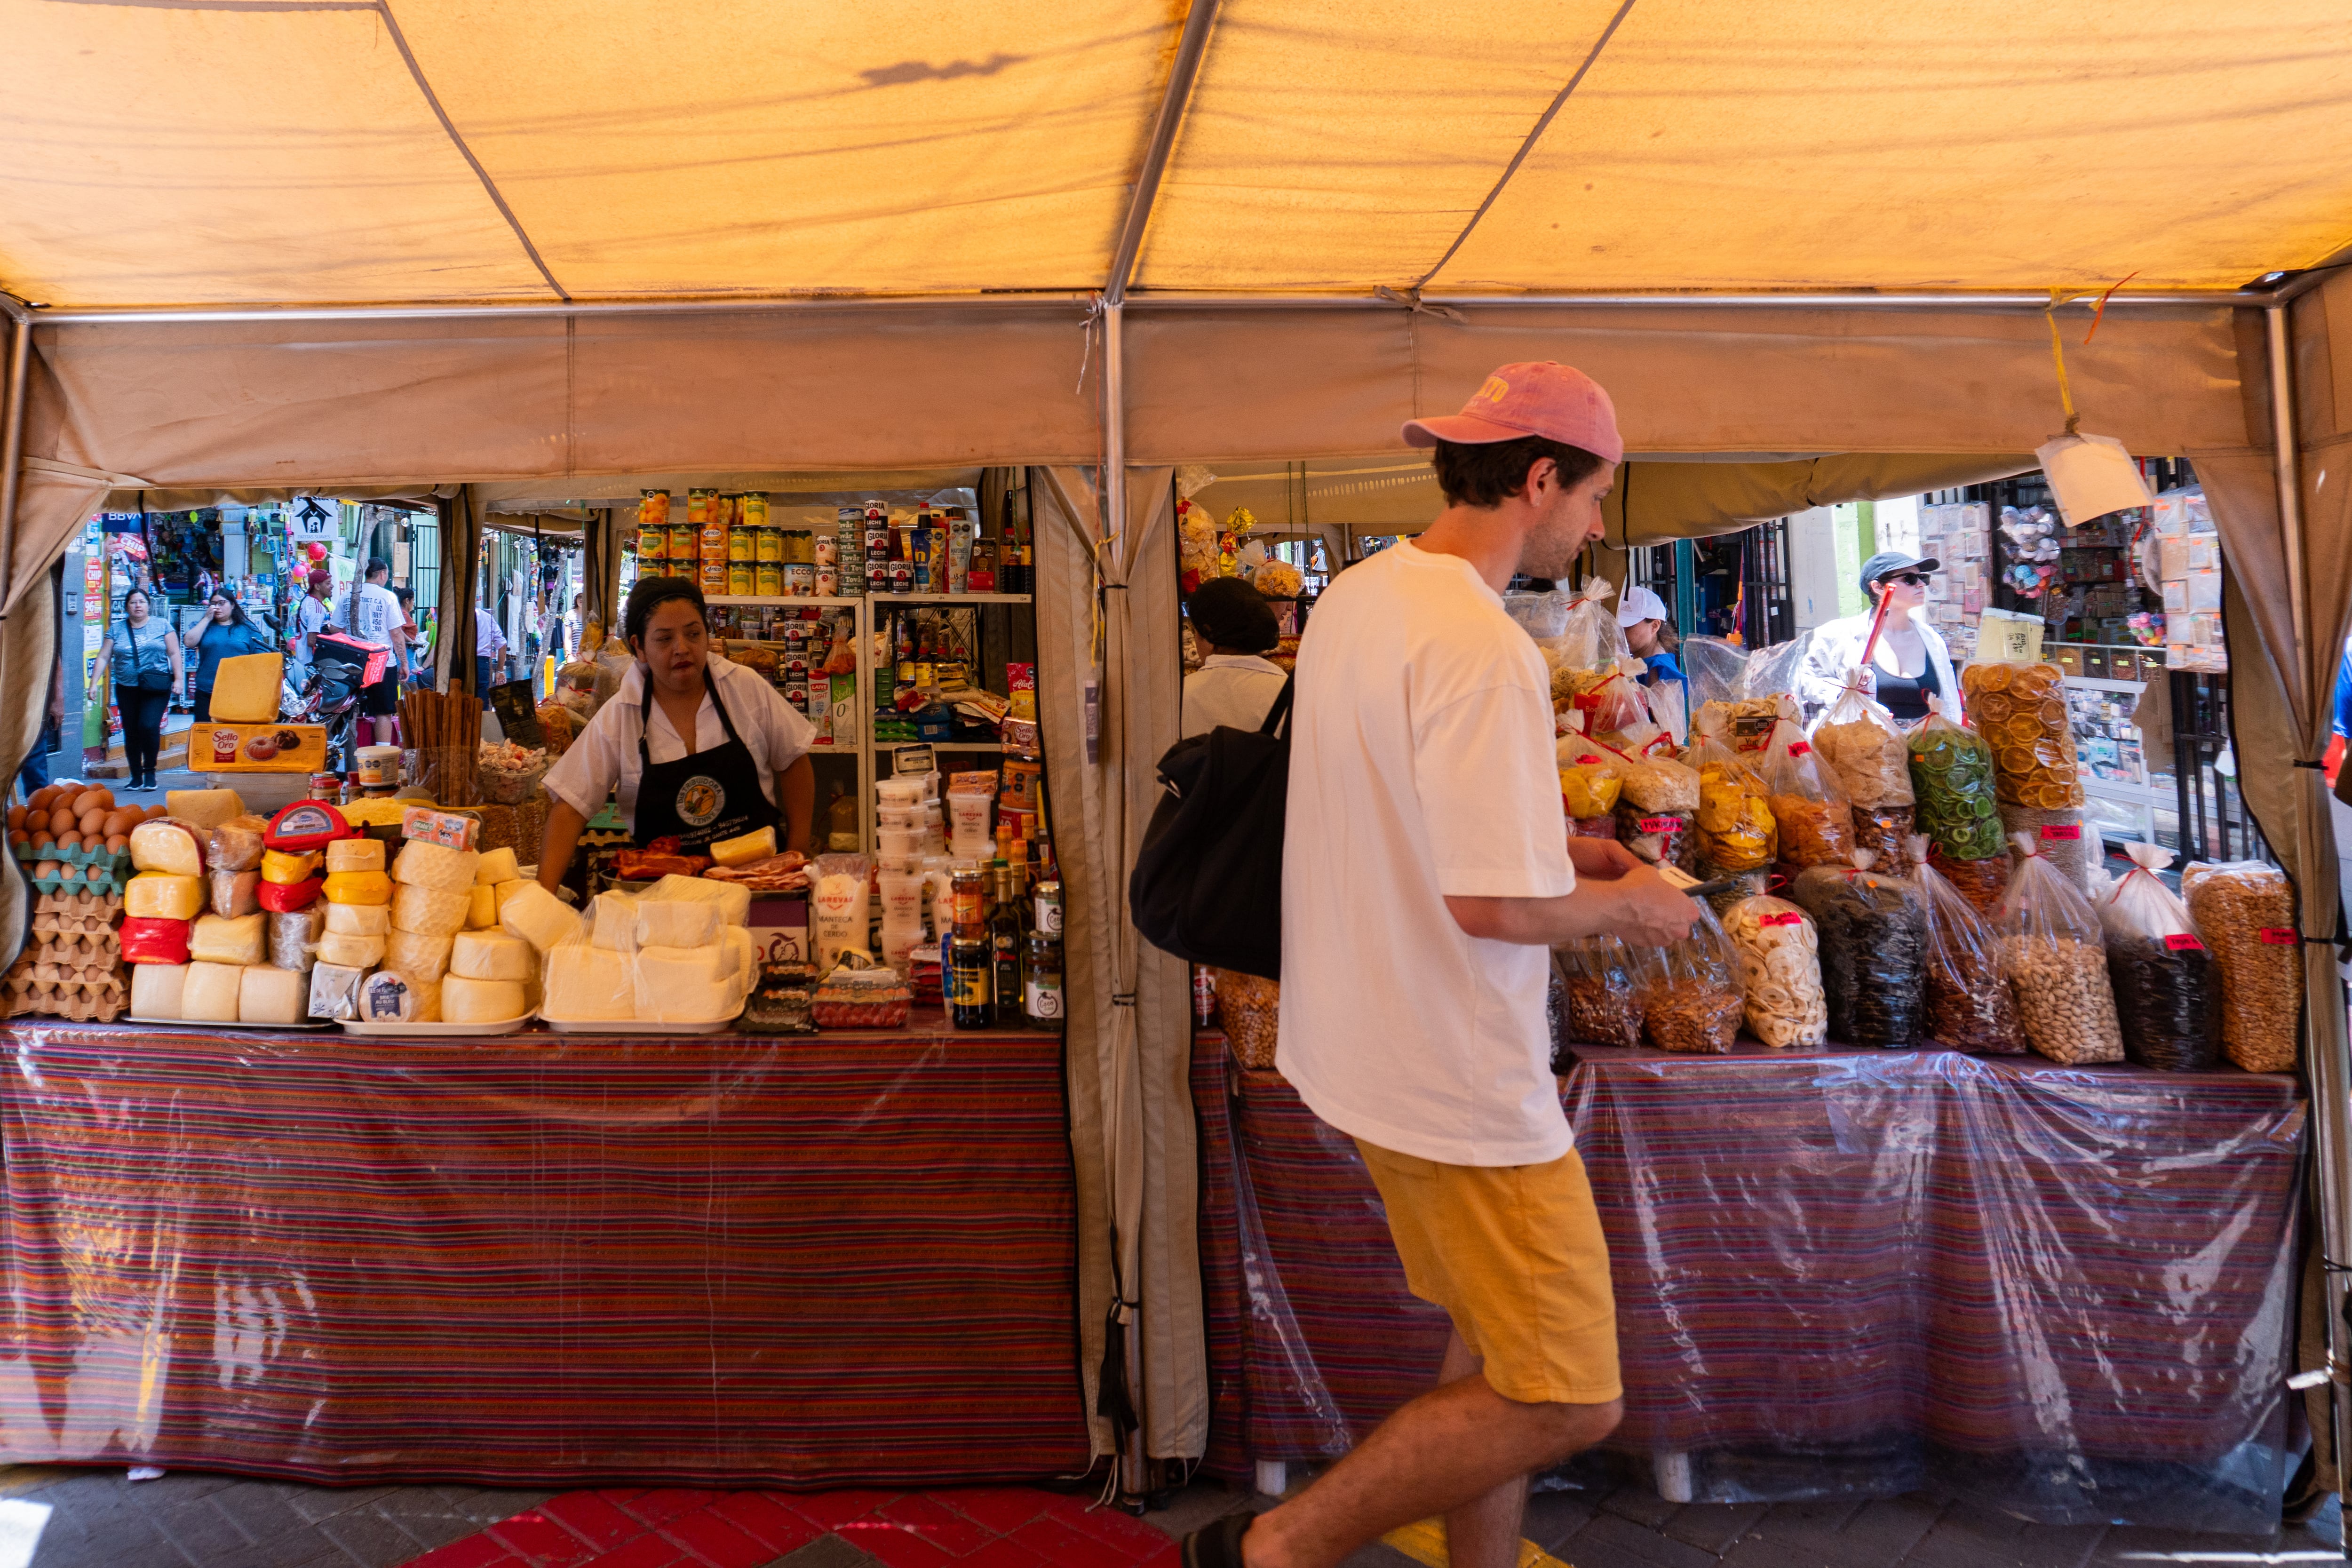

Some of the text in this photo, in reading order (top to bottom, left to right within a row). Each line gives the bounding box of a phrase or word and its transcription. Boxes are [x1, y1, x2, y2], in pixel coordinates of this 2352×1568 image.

[866, 502, 885, 510] GLORIA
[120, 537, 145, 552] CHIP
[890, 563, 911, 572] GLORIA
[785, 623, 805, 631] GLORIA
[786, 653, 807, 662] GLORIA
[786, 684, 807, 692] GLORIA
[811, 692, 828, 701] LIGHT
[212, 731, 238, 742] Sello
